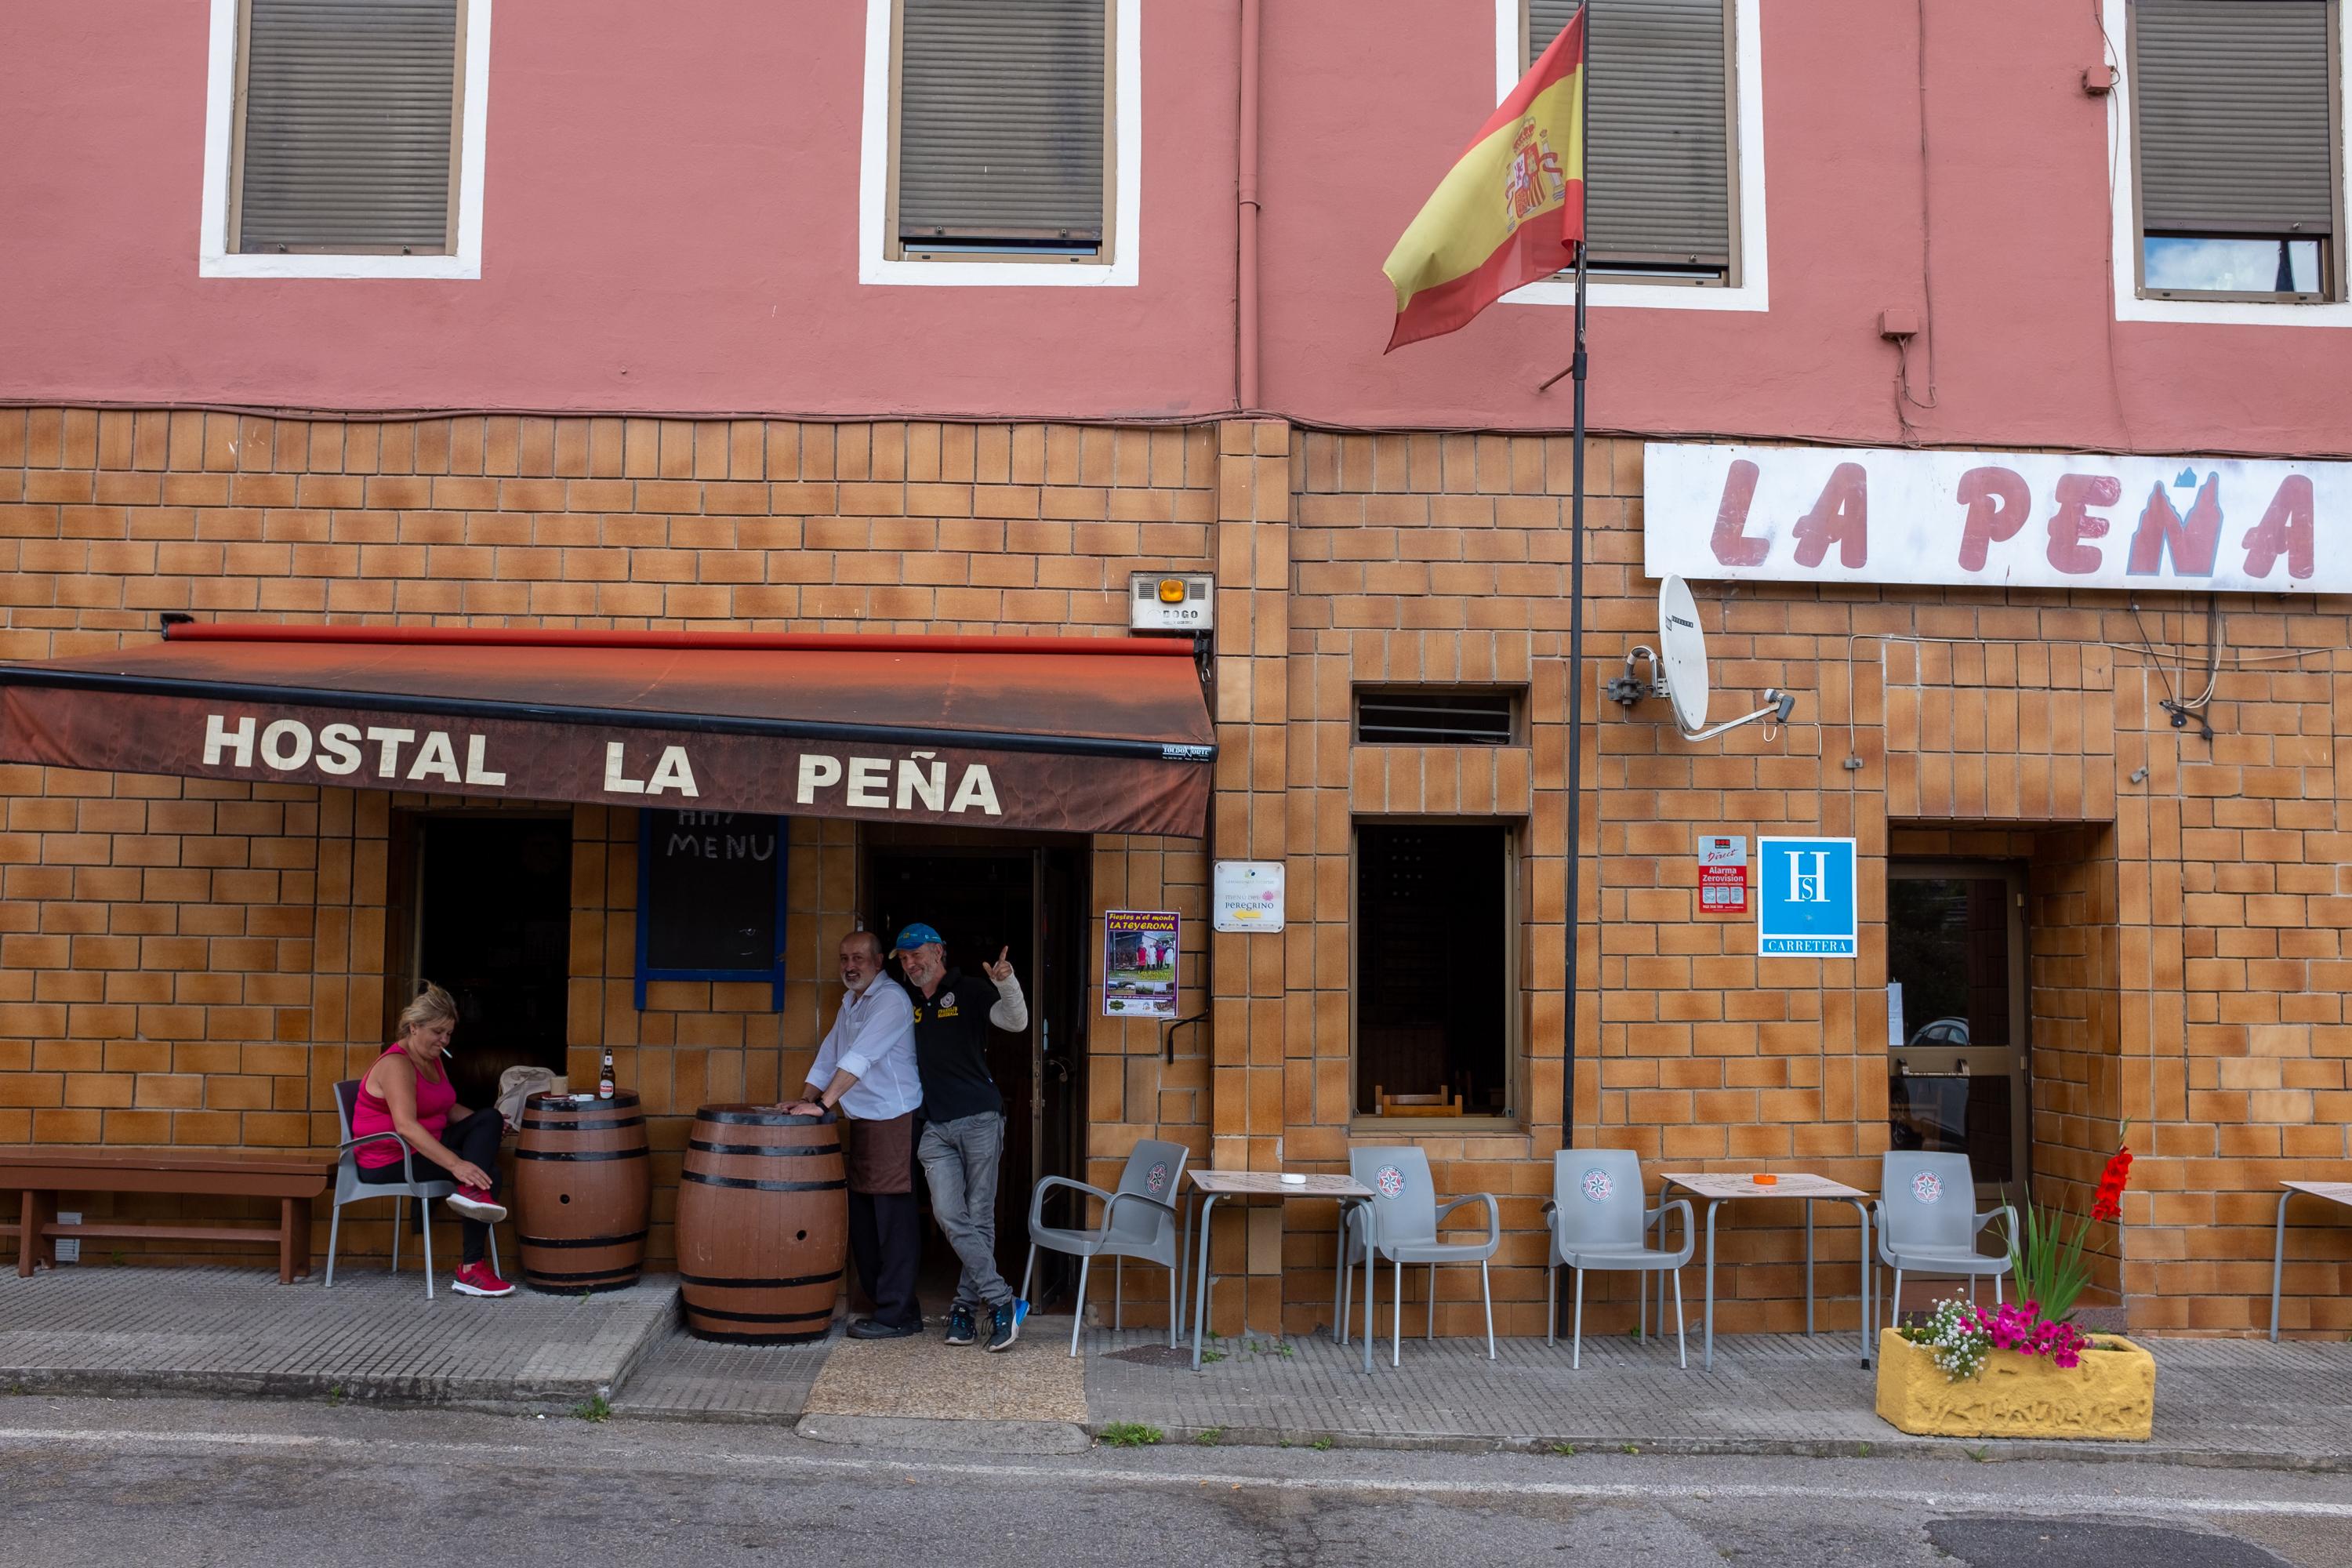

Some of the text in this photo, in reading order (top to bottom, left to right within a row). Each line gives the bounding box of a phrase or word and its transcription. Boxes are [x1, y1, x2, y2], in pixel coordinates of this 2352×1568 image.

[1710, 459, 2316, 580] LA PEÑA
[203, 714, 1001, 815] HOSTAL LA PEÑA
[666, 833, 775, 861] MENU
[1708, 849, 1738, 862] Direct
[1768, 940, 1846, 951] CARRETERA
